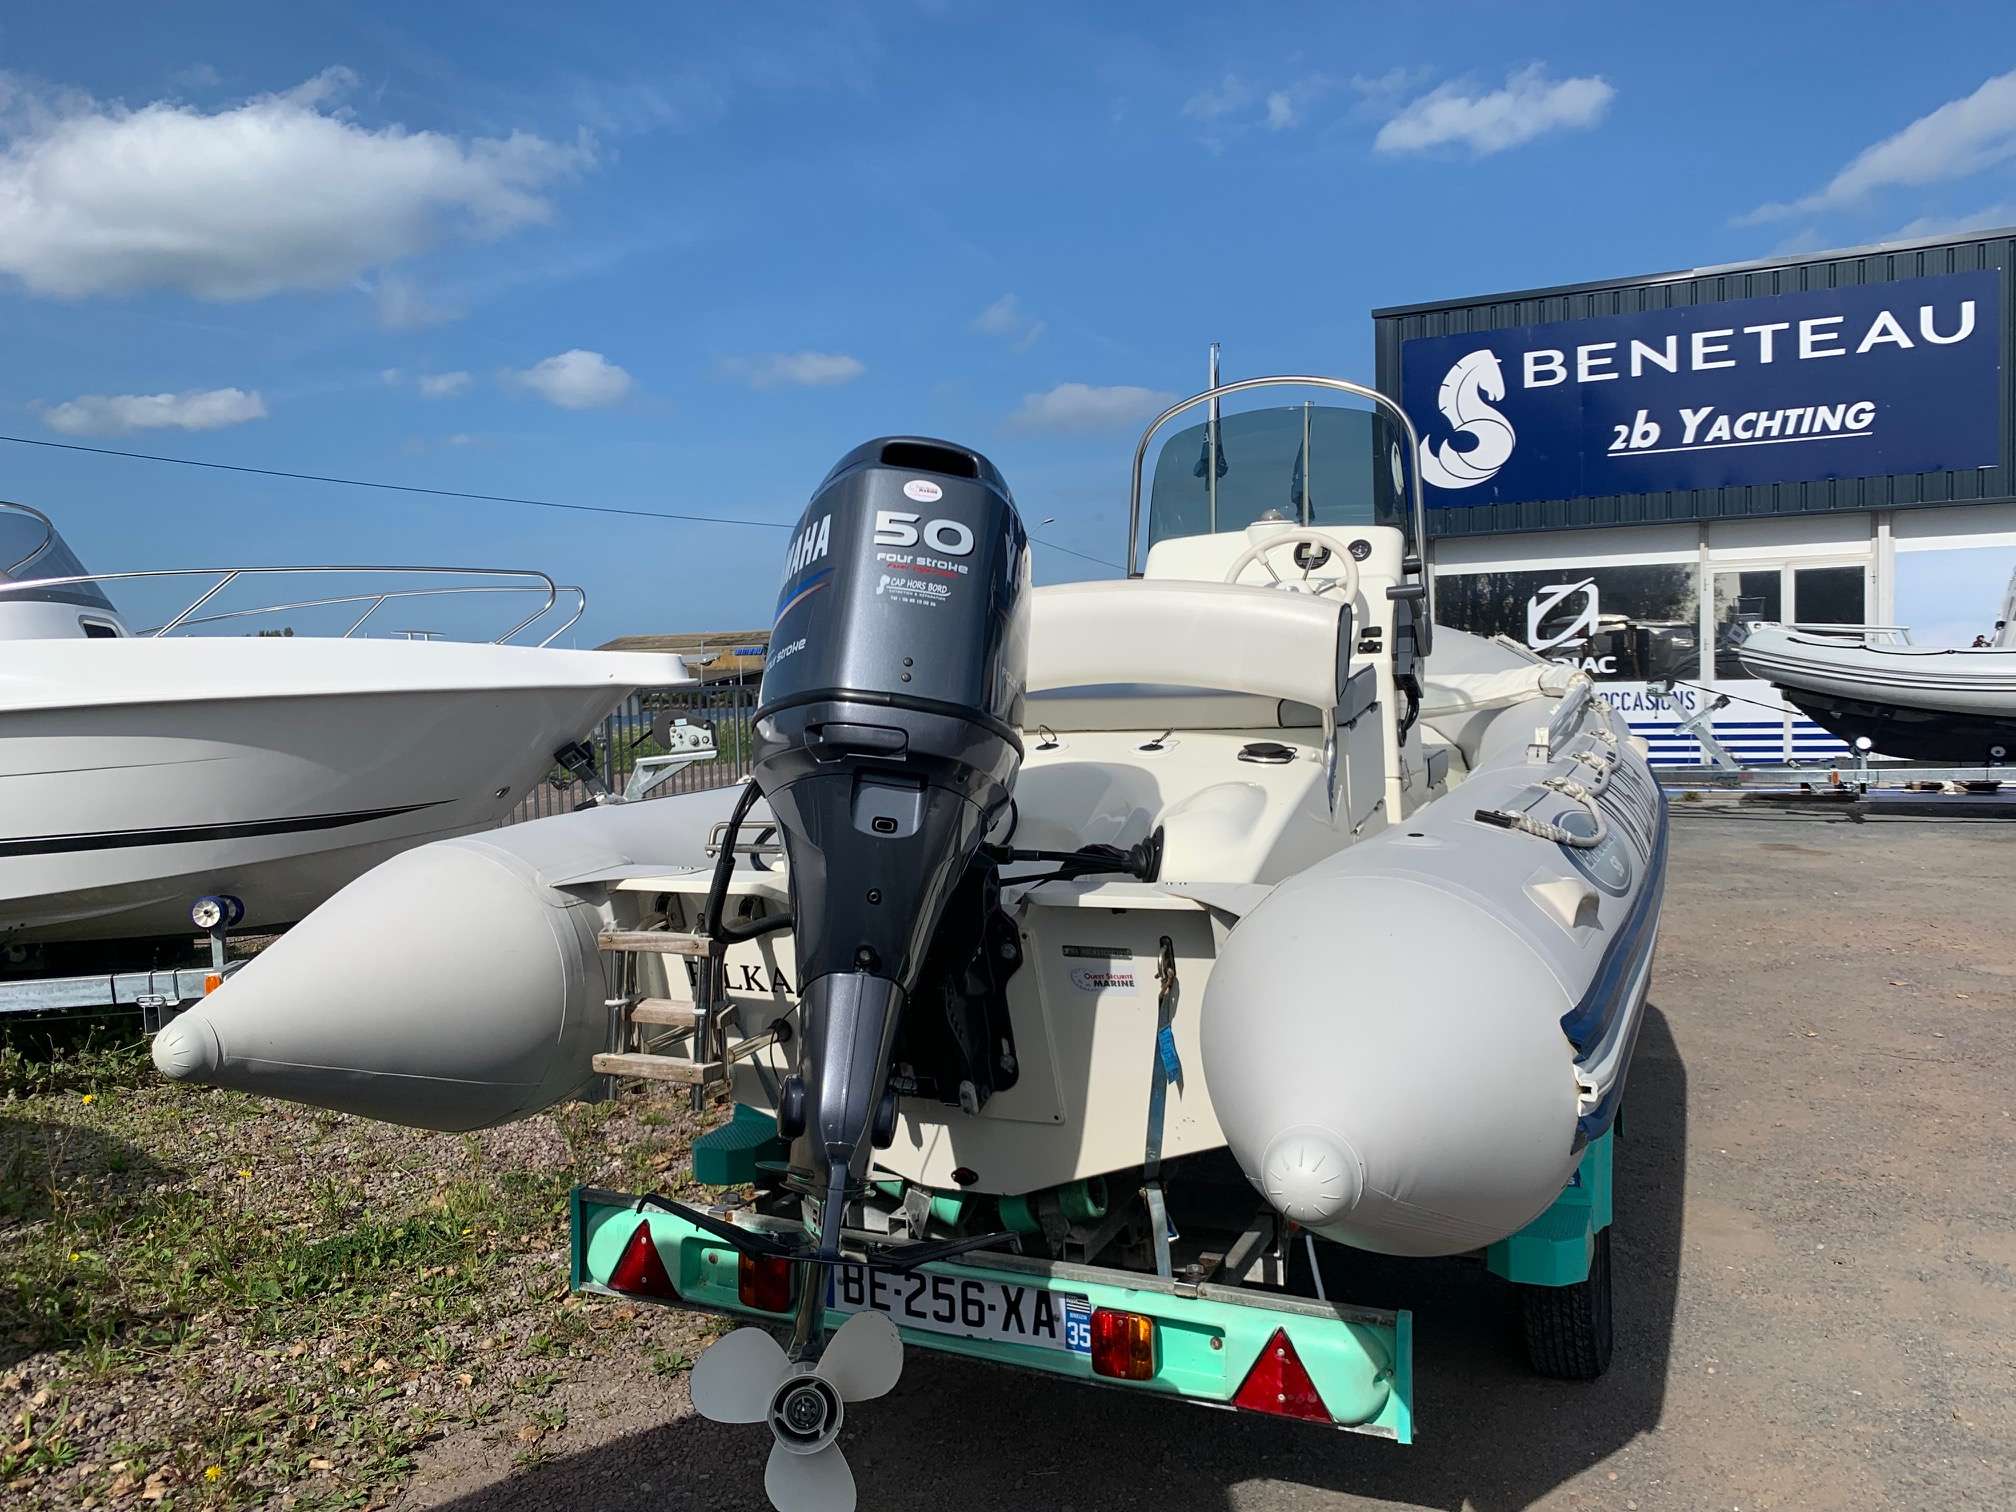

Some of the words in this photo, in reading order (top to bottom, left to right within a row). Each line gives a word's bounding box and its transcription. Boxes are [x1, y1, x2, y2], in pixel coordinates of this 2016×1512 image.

[1523, 301, 1976, 389] BENETEAU
[1607, 409, 1661, 451] 2b
[874, 511, 975, 556] 50
[891, 577, 906, 586] CAP
[907, 579, 927, 590] HORS
[928, 582, 948, 594] BORD
[1094, 980, 1135, 988] MARINE
[843, 1265, 1057, 1339] BE-256-XA
[1067, 1320, 1092, 1348] 35
